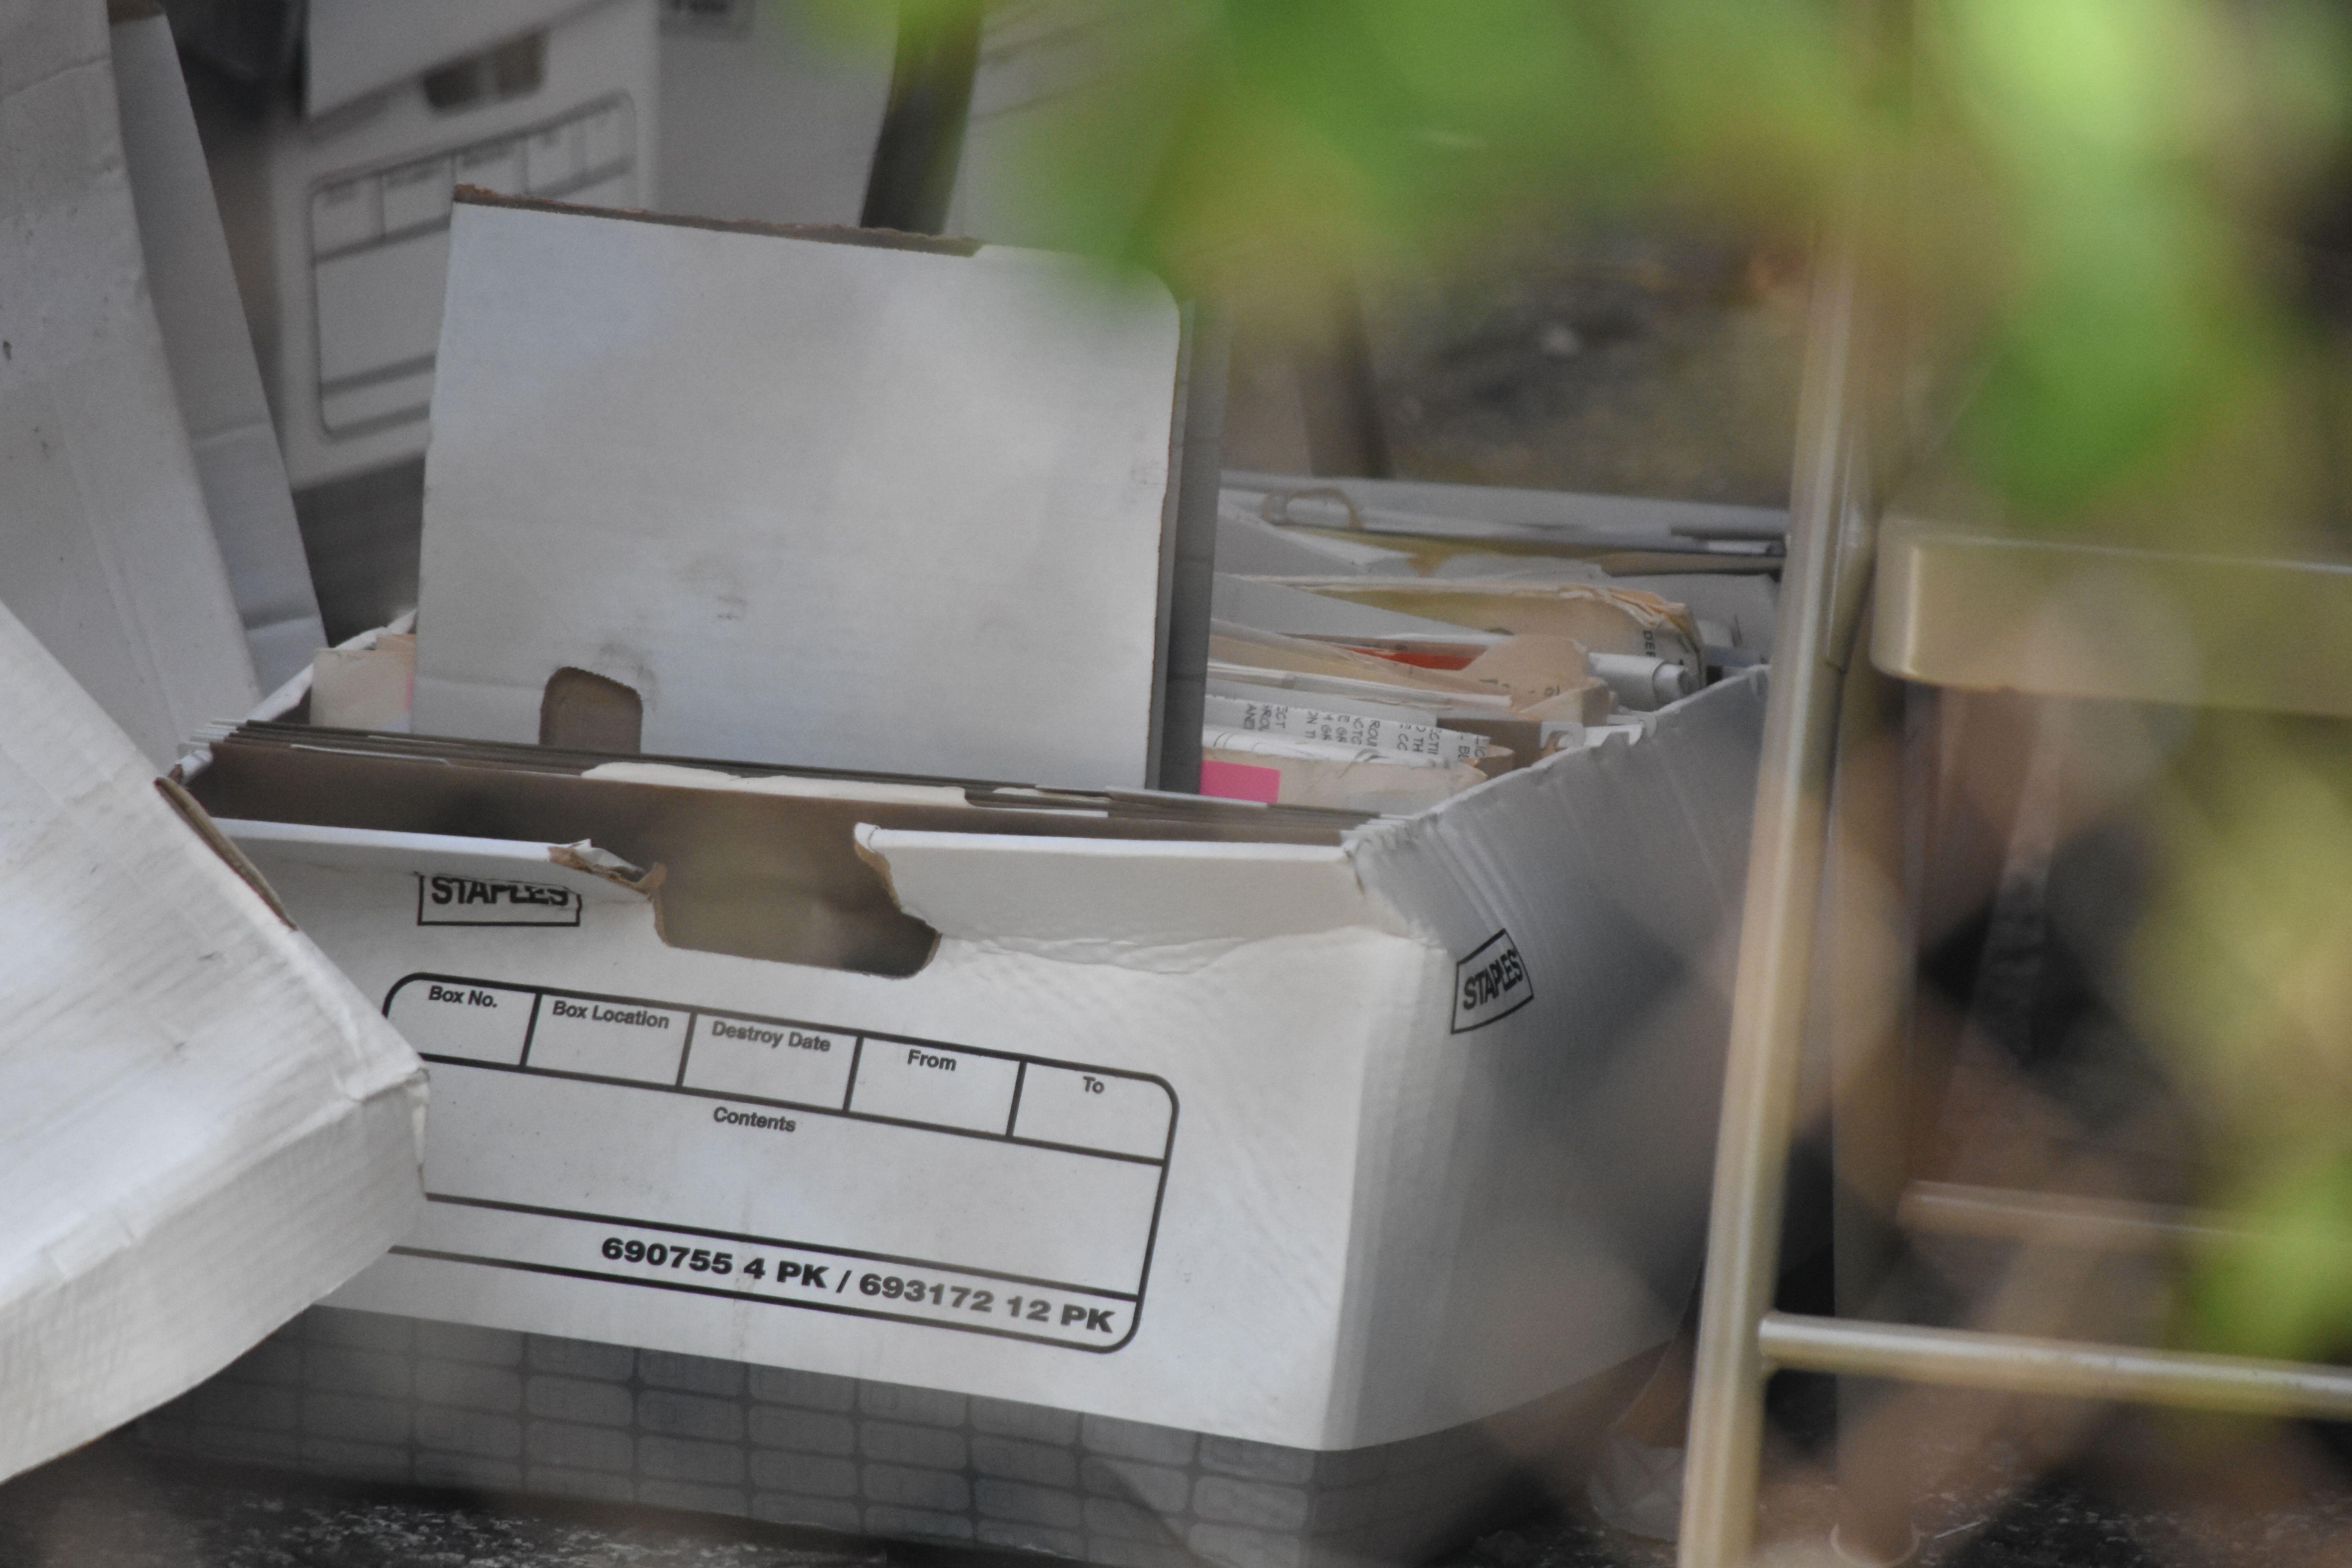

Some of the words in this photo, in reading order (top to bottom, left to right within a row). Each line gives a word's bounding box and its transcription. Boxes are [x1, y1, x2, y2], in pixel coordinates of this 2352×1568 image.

[432, 875, 569, 906] STAPLES
[1463, 949, 1523, 1010] STAPLES
[428, 985, 464, 1004] Box
[468, 990, 497, 1008] No.
[553, 1000, 588, 1019] Box
[592, 1005, 670, 1029] Location
[711, 1020, 784, 1049] Destroy
[788, 1031, 831, 1052] Date
[907, 1049, 957, 1071] From
[1082, 1076, 1105, 1095] To
[713, 1107, 797, 1132] Contents
[602, 1237, 733, 1275] 690755
[744, 1258, 766, 1279] 4
[776, 1260, 831, 1289] PK
[835, 1270, 853, 1293] /
[859, 1273, 995, 1313] 693172
[1007, 1297, 1052, 1323] 12
[1060, 1304, 1115, 1333] PK
